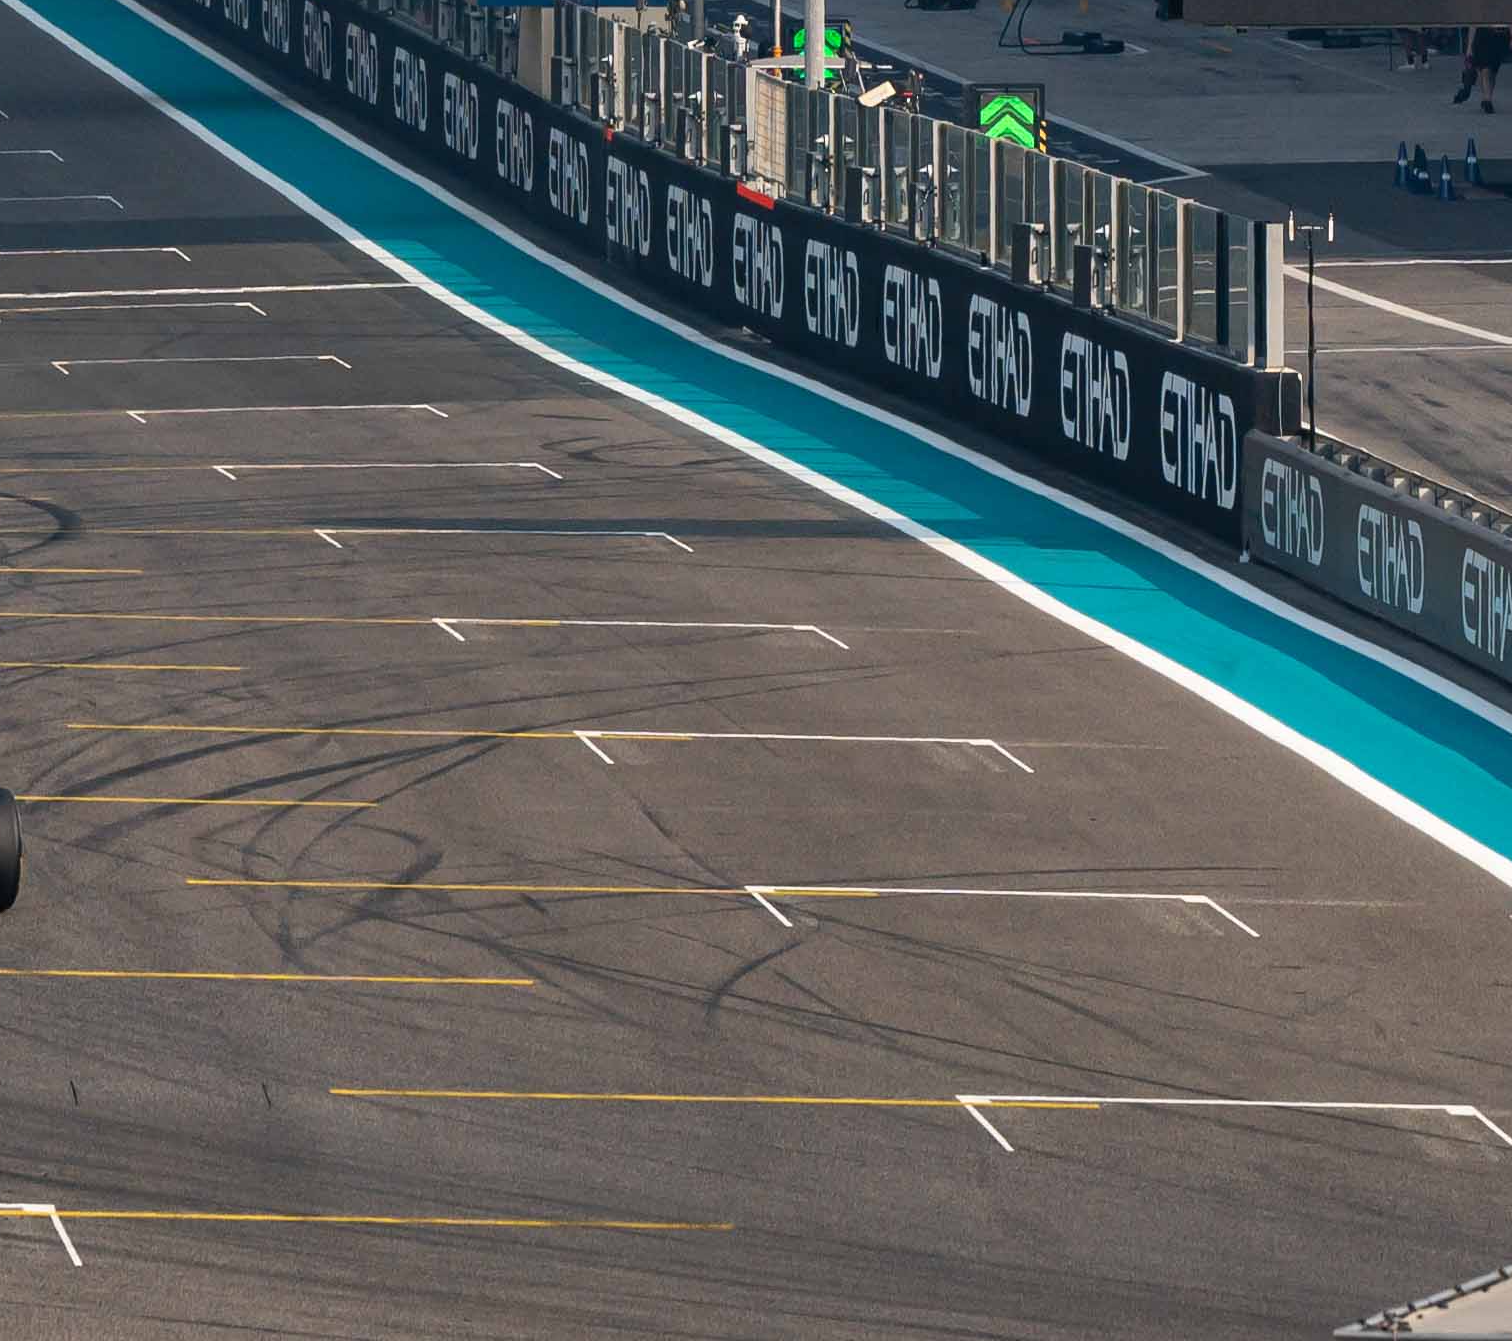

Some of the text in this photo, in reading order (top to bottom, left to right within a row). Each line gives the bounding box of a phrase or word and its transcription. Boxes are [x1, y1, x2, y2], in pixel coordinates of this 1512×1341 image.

[443, 72, 479, 160] ETIHAD
[496, 98, 533, 192] ETIHAD
[549, 127, 589, 225] ETIHAD
[606, 155, 651, 256] ETIHAD
[666, 184, 714, 287] ETIHAD
[733, 212, 784, 318] ETIHAD
[805, 239, 860, 348] ETIHAD
[883, 264, 942, 379] ETIHAD
[968, 294, 1032, 417] ETIHAD
[1060, 332, 1131, 461] ETIHAD
[1160, 371, 1238, 509] ETIHAD
[1261, 457, 1325, 566] ETIHAD
[1357, 503, 1425, 614] ETIHAD
